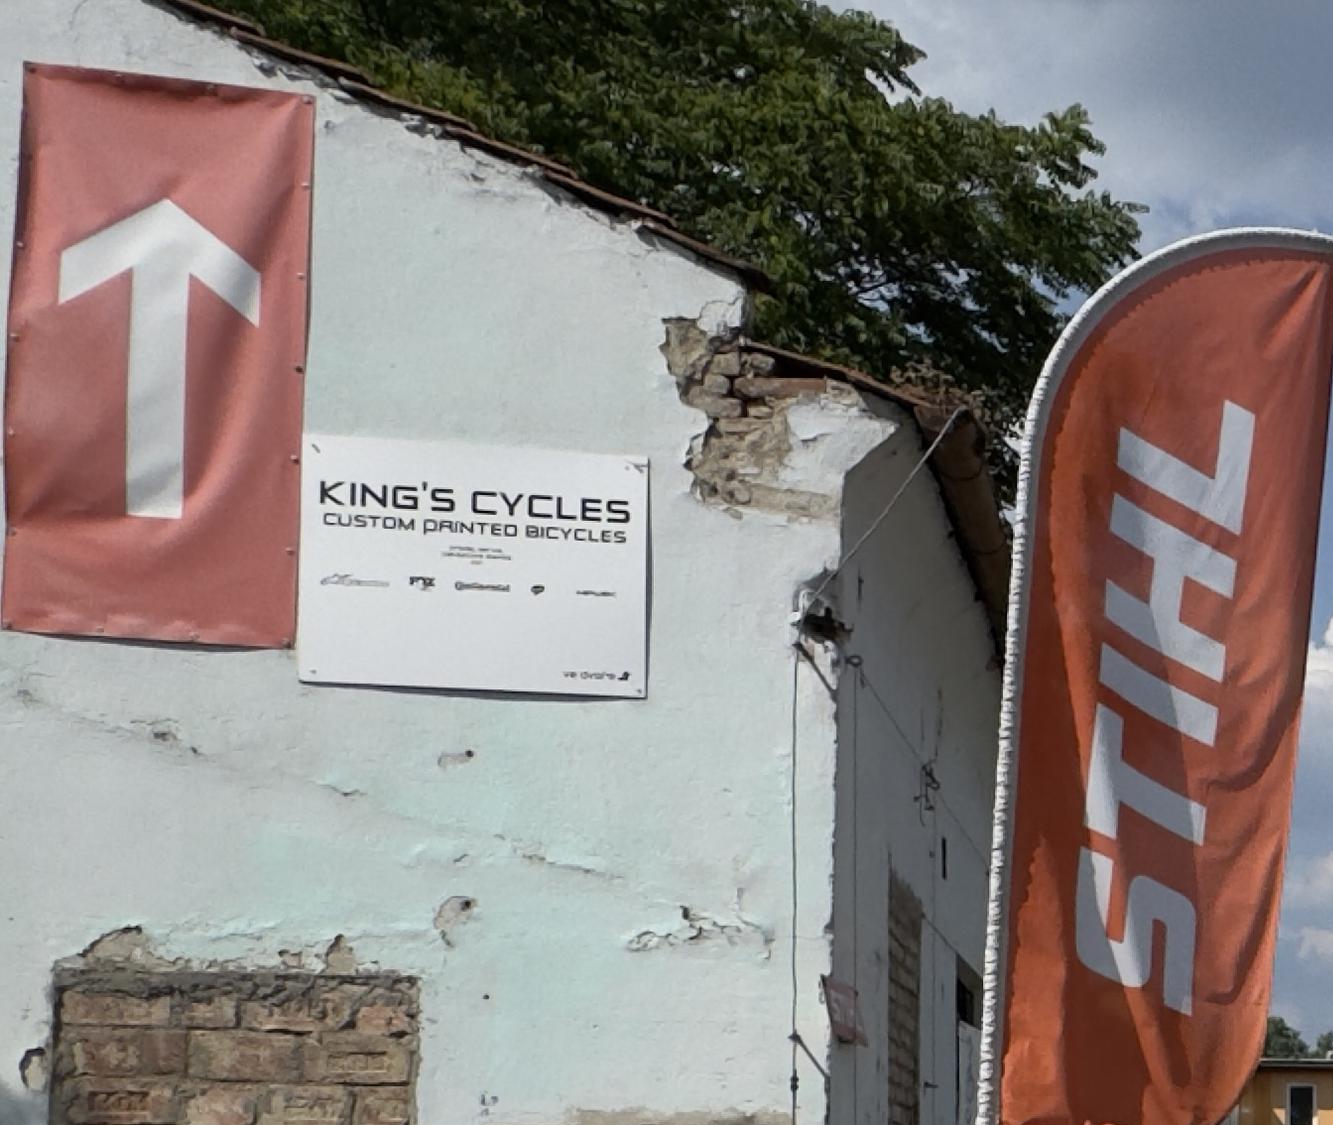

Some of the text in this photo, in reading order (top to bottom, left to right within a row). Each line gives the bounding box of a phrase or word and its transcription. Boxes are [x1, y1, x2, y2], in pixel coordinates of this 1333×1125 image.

[319, 480, 631, 524] KING'S CYCLES
[323, 512, 628, 544] CUSTOM PAINTED BICYCLES
[1073, 400, 1256, 1017] STIHL
